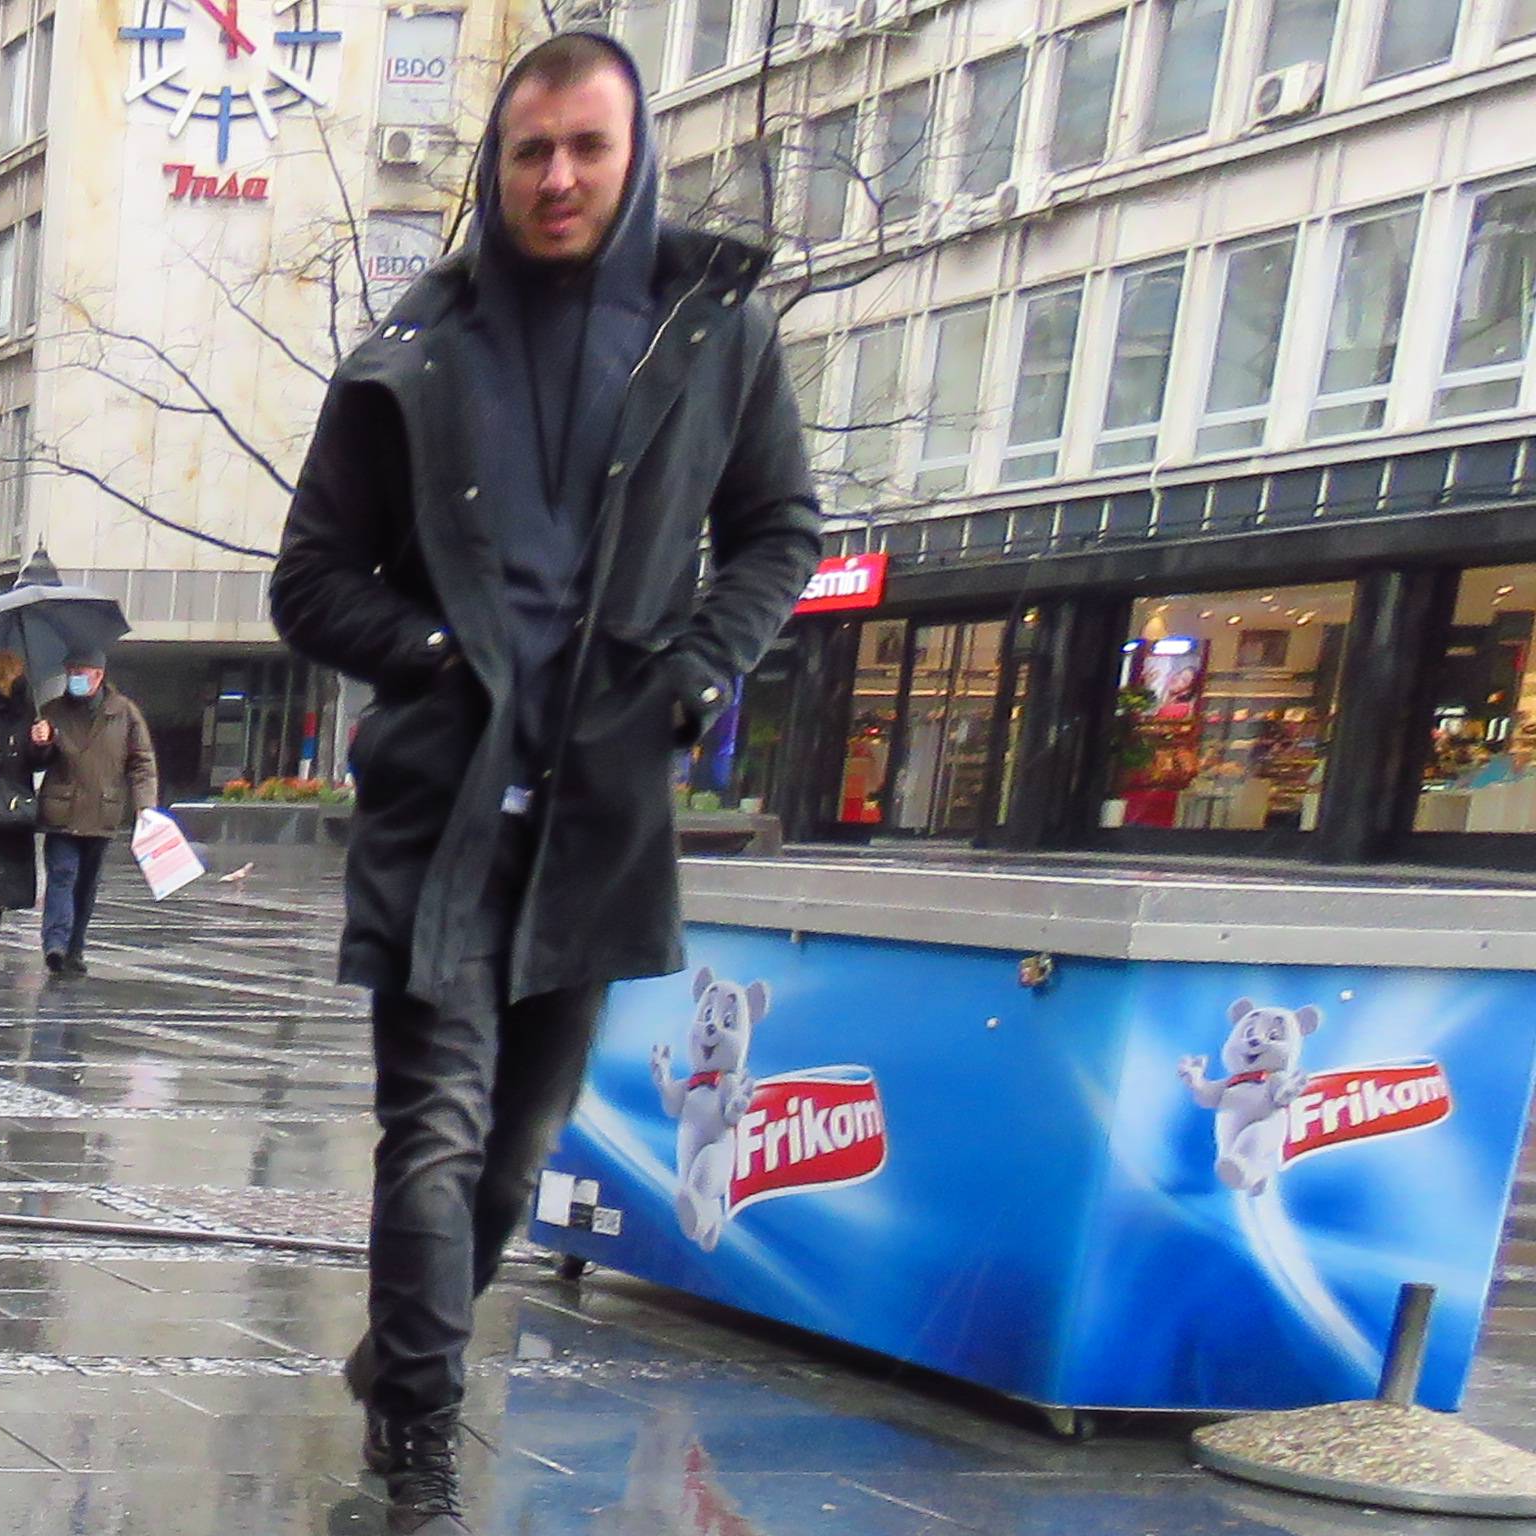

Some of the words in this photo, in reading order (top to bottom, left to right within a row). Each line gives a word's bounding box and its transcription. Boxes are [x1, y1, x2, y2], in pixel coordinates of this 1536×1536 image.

[395, 57, 446, 78] BDO
[162, 163, 269, 201] Insa
[1289, 1075, 1450, 1144] Frikom
[735, 1095, 885, 1182] Frikom
